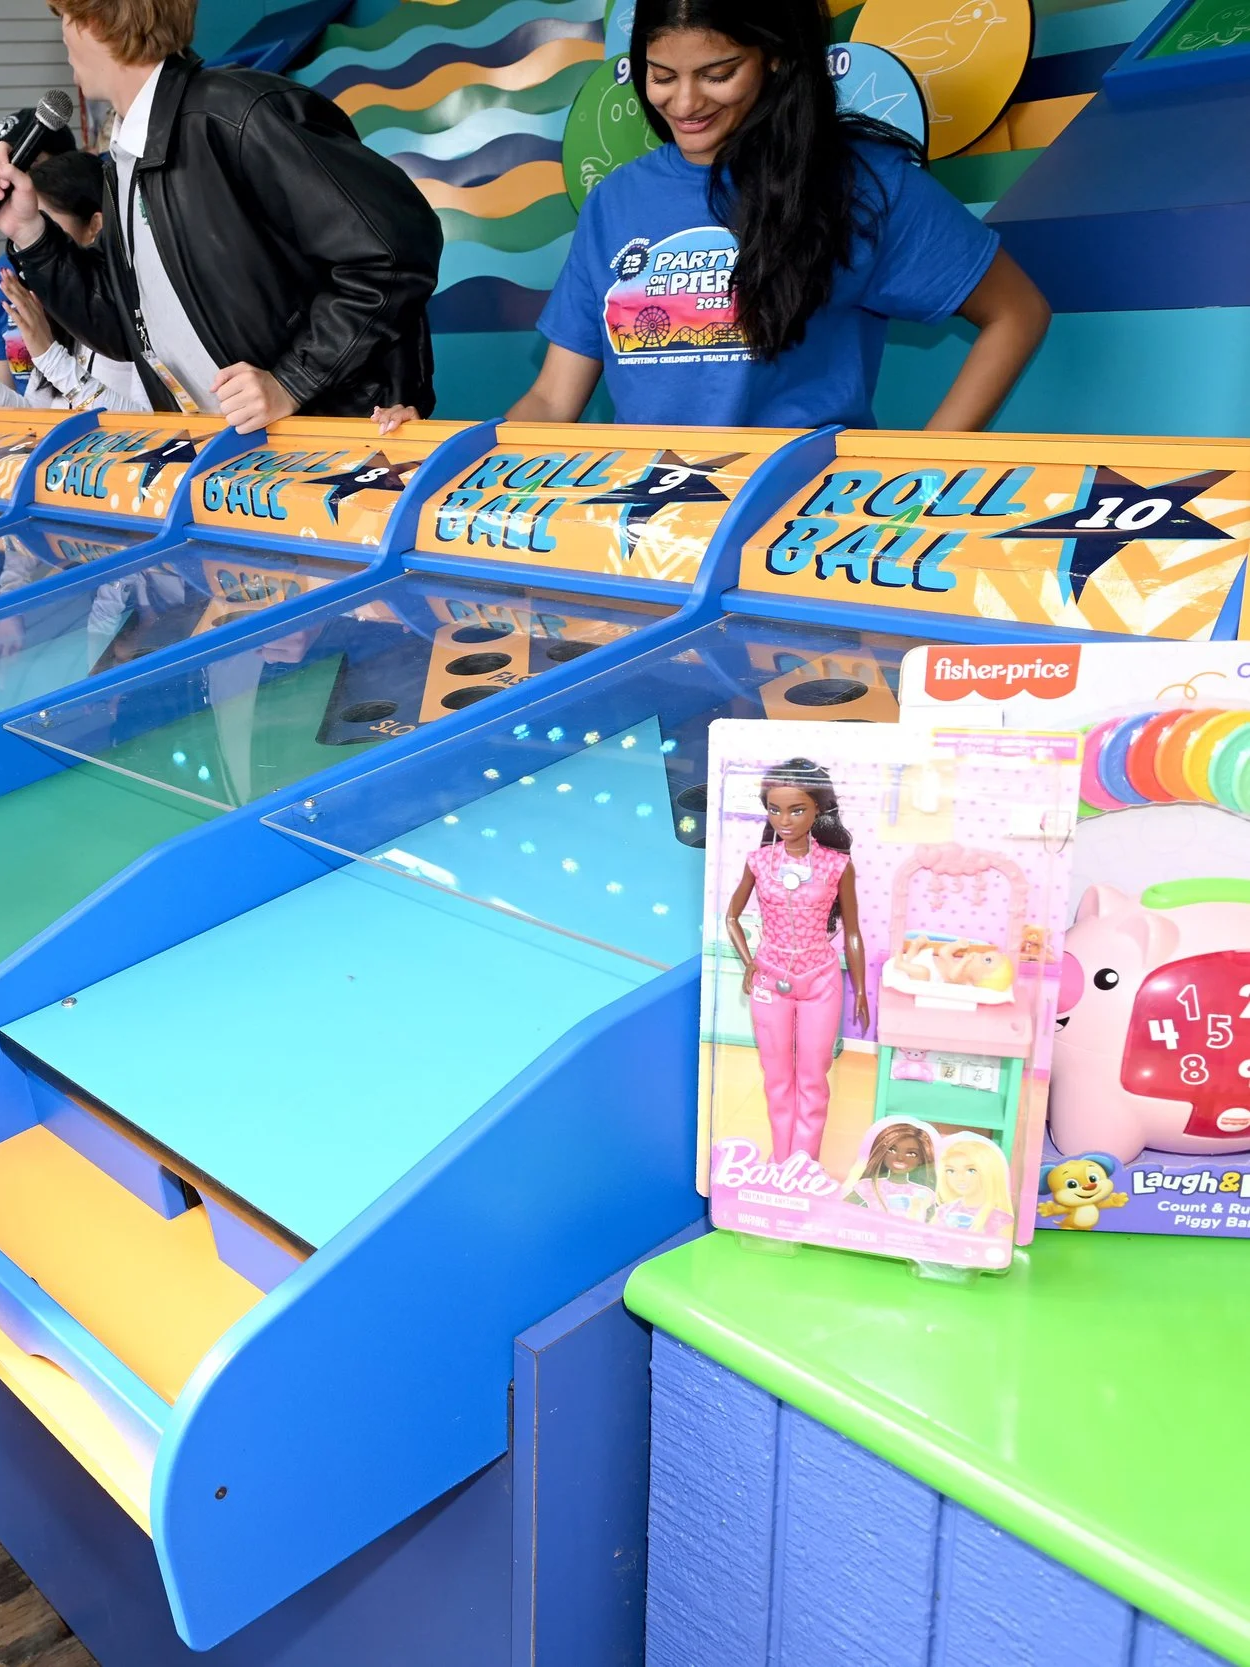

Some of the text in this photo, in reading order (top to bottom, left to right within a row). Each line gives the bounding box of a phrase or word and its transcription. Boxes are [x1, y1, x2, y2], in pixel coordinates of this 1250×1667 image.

[623, 253, 642, 269] 25
[654, 247, 739, 272] PARTY
[646, 284, 667, 297] THE
[650, 274, 668, 285] ON
[670, 269, 732, 295] PIER
[696, 296, 731, 310] 2025
[618, 356, 657, 365] BENEFITING
[659, 355, 700, 364] CHILDREN'S
[703, 354, 729, 362] HEALTH
[62, 430, 160, 454] ROLL
[221, 450, 351, 473] ROLL
[458, 450, 626, 489] ROLL
[45, 454, 117, 499] BALL
[354, 467, 390, 483] 8
[648, 468, 692, 495] 9
[203, 471, 295, 520] BALL
[796, 465, 1038, 519] ROLL
[434, 490, 567, 553] BALL
[1075, 498, 1173, 531] 10
[765, 517, 969, 592] BALL
[486, 671, 534, 686] FAS
[934, 657, 1070, 684] fisher-price
[369, 719, 417, 736] SLO
[1176, 984, 1200, 1021] 1
[1148, 1013, 1234, 1050] 4 5
[1180, 1053, 1209, 1085] 8
[715, 1138, 839, 1196] Barbie
[1157, 1201, 1207, 1213] Count
[1211, 1203, 1223, 1213] &
[1174, 1214, 1222, 1229] Piggy
